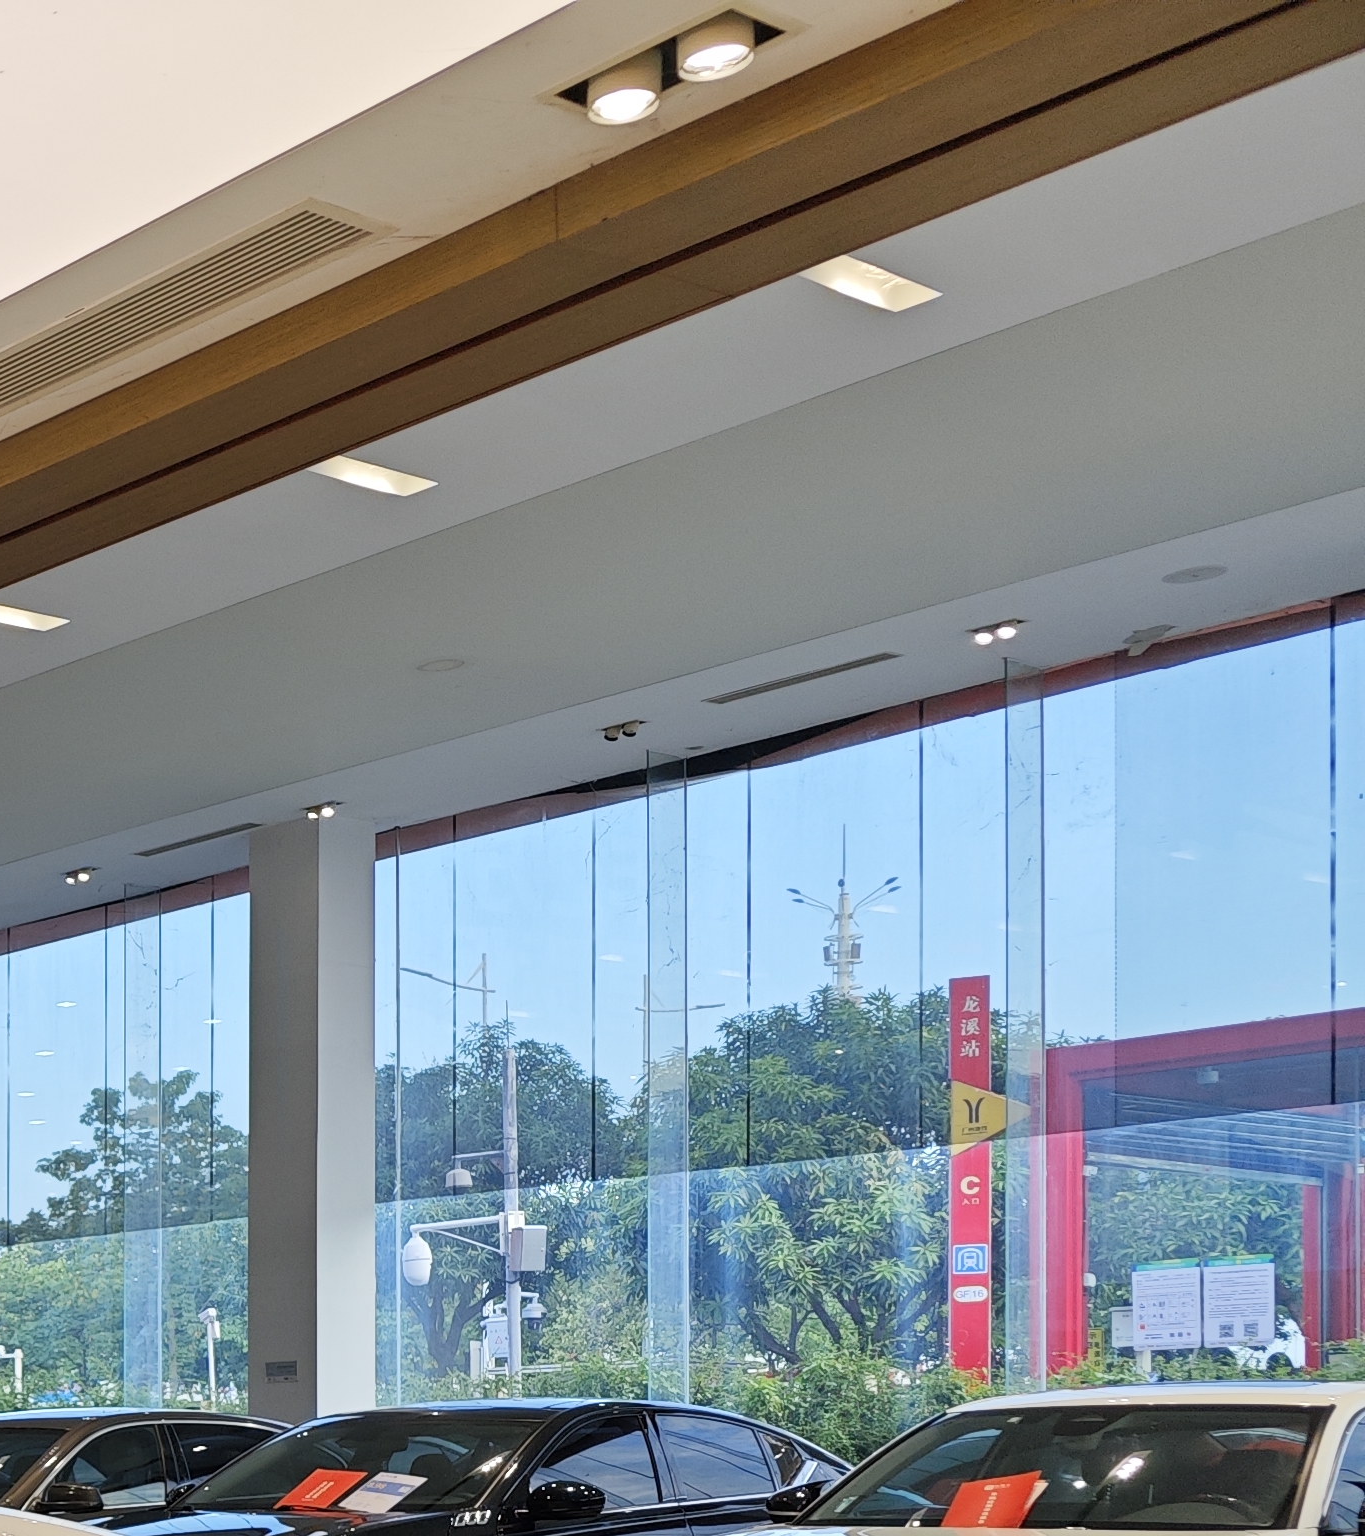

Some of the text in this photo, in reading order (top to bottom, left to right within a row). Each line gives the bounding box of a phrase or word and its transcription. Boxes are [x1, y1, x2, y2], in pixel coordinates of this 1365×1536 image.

[959, 995, 981, 1058] 龙溪站
[960, 1175, 981, 1195] C
[961, 1197, 980, 1206] 入口
